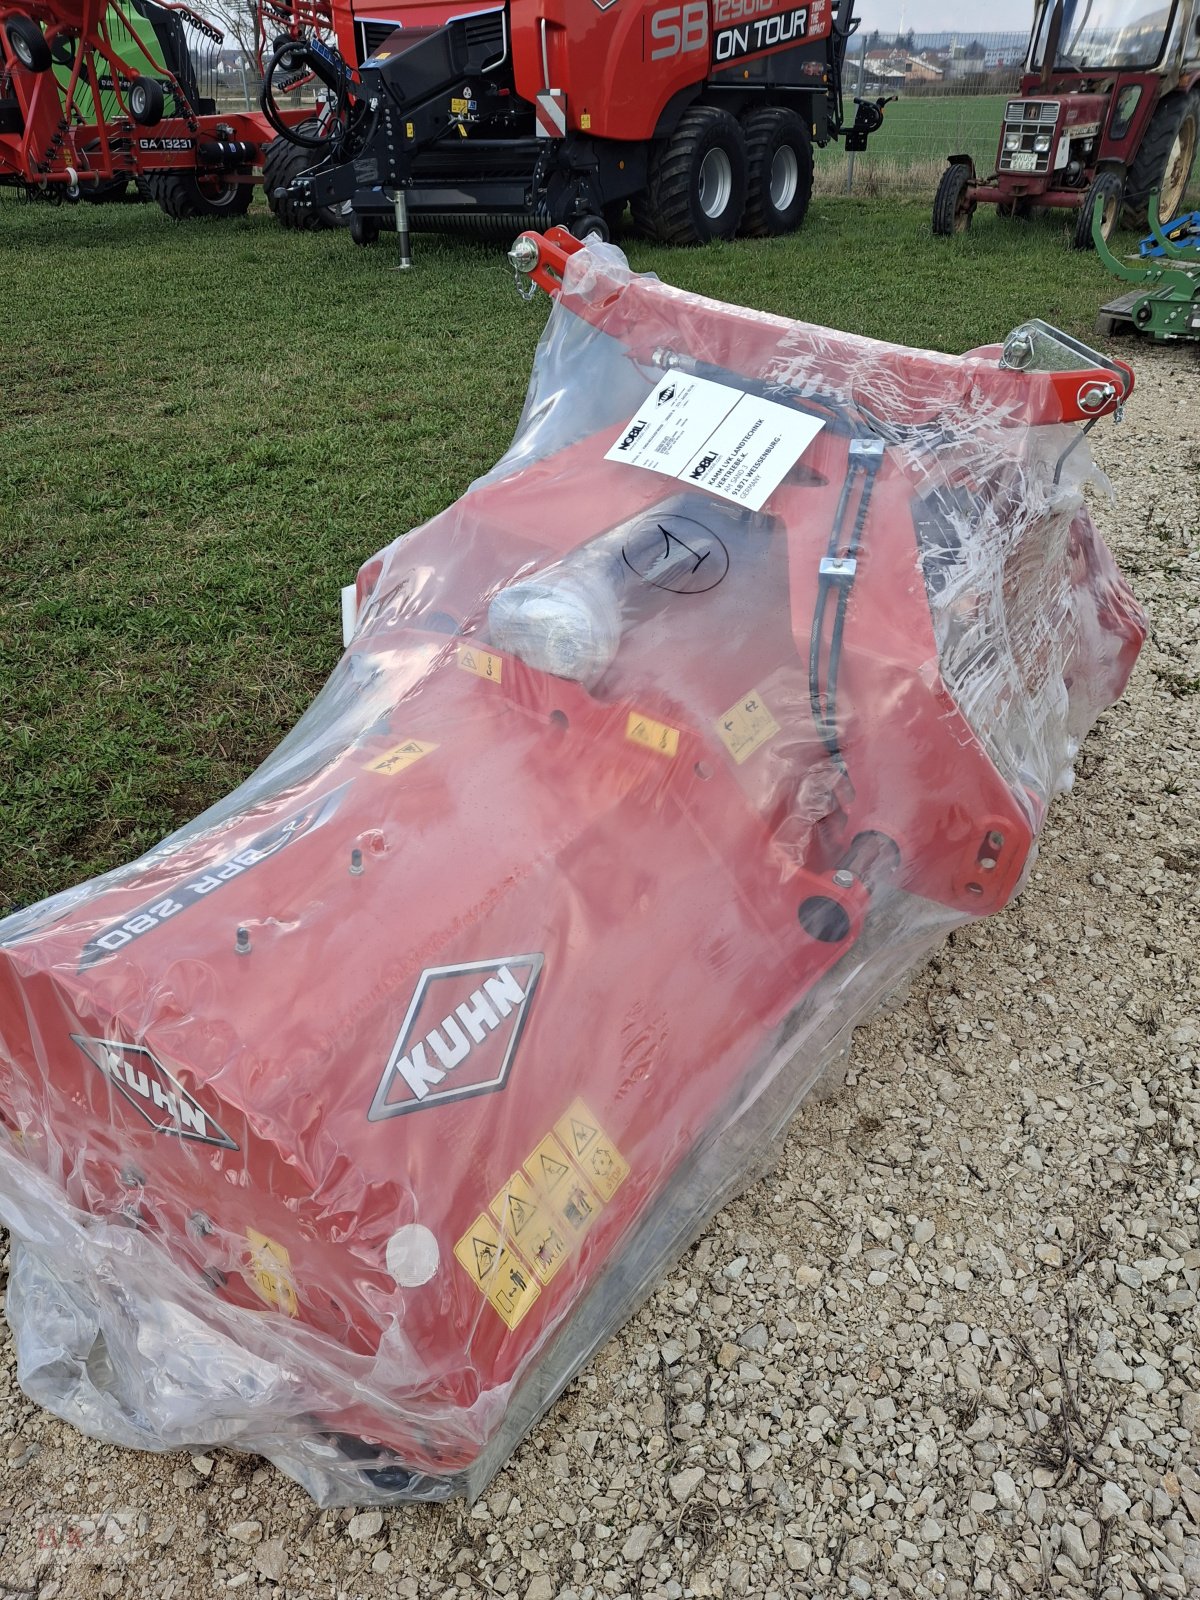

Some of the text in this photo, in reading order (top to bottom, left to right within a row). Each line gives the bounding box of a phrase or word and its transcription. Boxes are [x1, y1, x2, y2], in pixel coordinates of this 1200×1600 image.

[651, 1, 708, 61] SB
[716, 8, 807, 60] ON TOUR
[140, 139, 192, 149] GA 13231
[618, 420, 647, 450] NOBILI
[708, 418, 764, 485] KAMM LVK LANDTECHNIK
[689, 451, 719, 480] NOBILI
[732, 478, 749, 495] 91871
[746, 437, 781, 478] WEISSENBURG
[740, 473, 761, 499] GERMANY
[97, 848, 263, 950] BPR 280
[395, 965, 526, 1101] KUHN
[106, 1051, 207, 1138] KUHN
